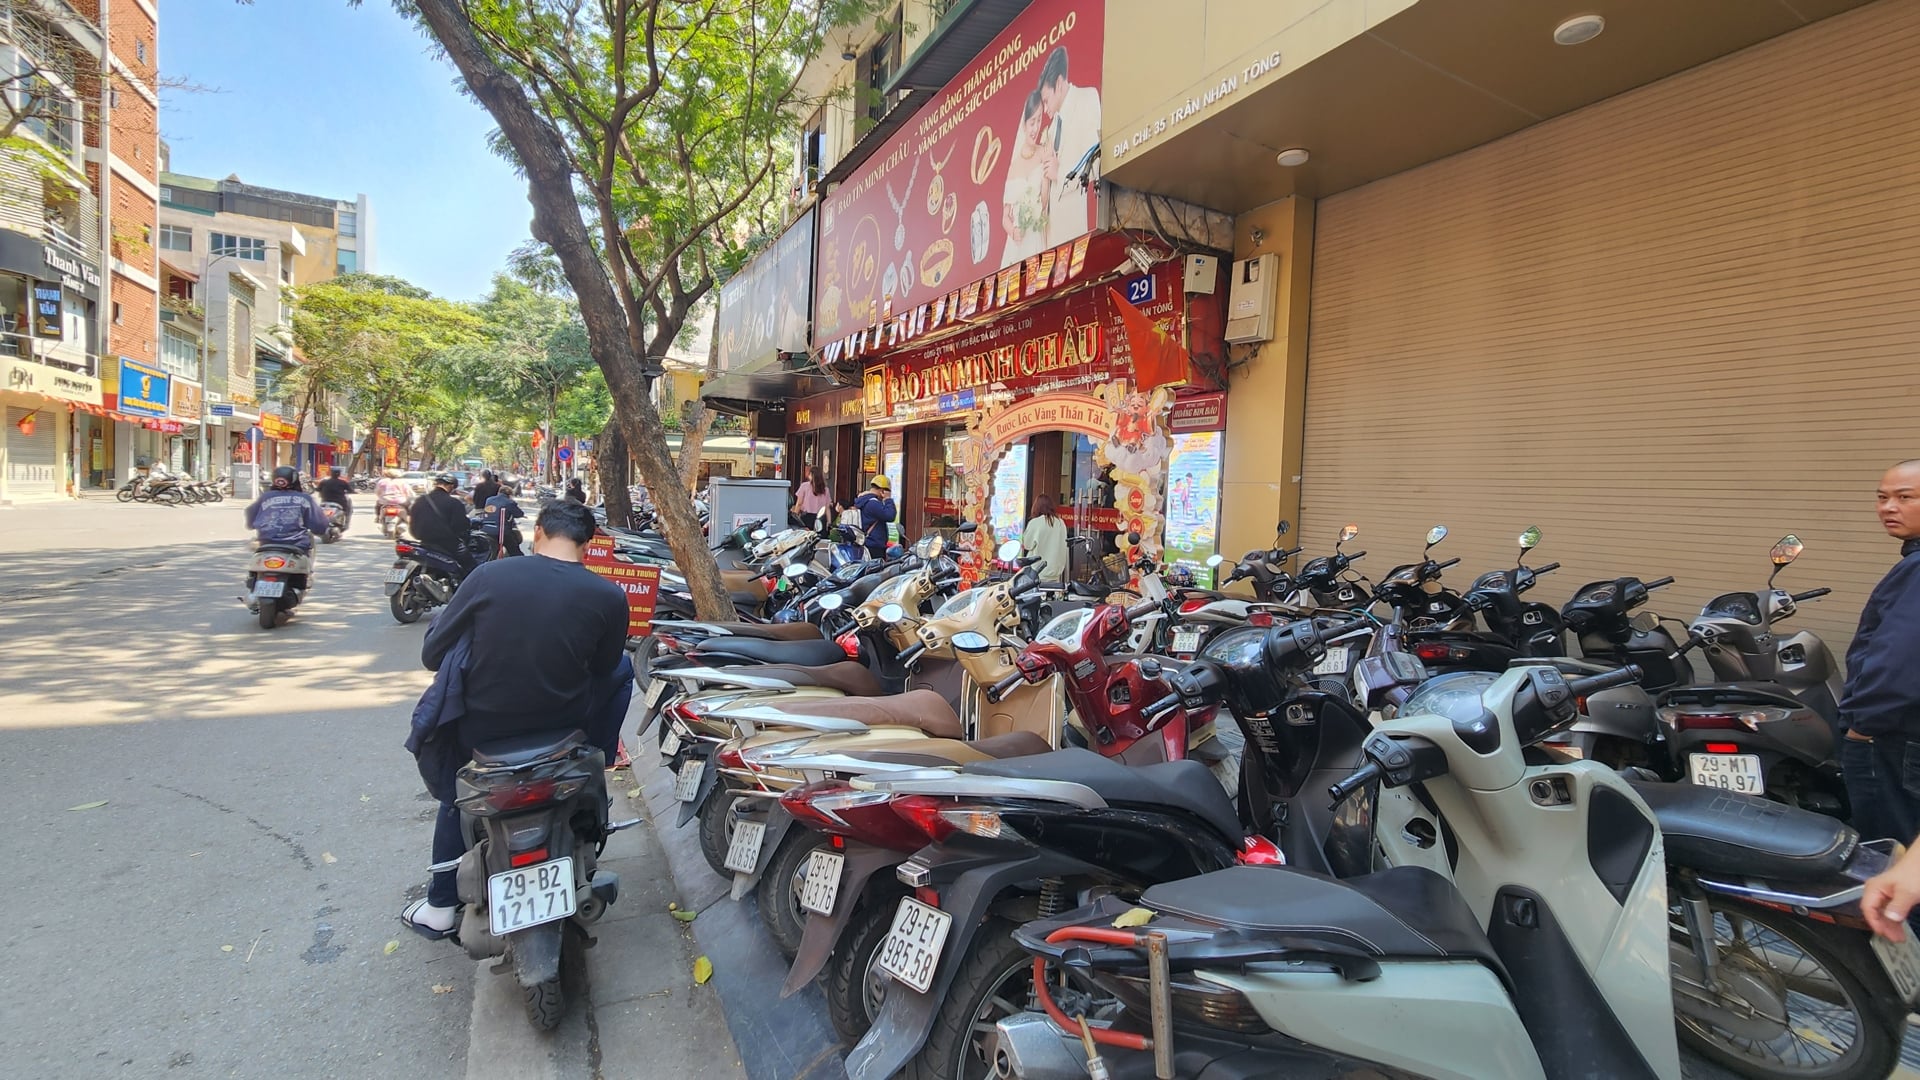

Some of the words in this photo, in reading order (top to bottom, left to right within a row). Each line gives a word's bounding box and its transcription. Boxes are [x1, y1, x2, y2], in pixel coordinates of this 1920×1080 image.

[918, 128, 938, 157] VÀNG
[938, 106, 965, 139] TRANG
[965, 92, 982, 118] SỨC
[983, 67, 1009, 100] CHẤT
[1009, 35, 1047, 80] LƯỢNG
[1049, 11, 1077, 45] CAO
[919, 110, 939, 136] VÀNG
[939, 89, 963, 119] RỒNG
[963, 59, 993, 99] THĂNG
[994, 34, 1022, 71] LONG
[1113, 140, 1129, 158] ĐỊA
[1154, 117, 1167, 135] 35
[1170, 99, 1200, 126] TRẦN
[1203, 75, 1238, 106] NHÂN
[1242, 51, 1281, 83] TÔNG
[838, 192, 851, 215] BẢO
[852, 181, 864, 203] TÍN
[864, 160, 886, 193] MINH
[886, 139, 911, 173] CHÂU
[44, 246, 80, 277] Thanh
[1130, 279, 1149, 301] 29
[890, 363, 920, 403] BẢO
[954, 344, 1016, 391] MINH
[1019, 316, 1100, 376] CHÂU
[1017, 412, 1032, 427] Lộc
[1034, 407, 1057, 421] Vàng
[1087, 408, 1104, 426] Tài
[592, 547, 608, 557] DÂN
[614, 566, 626, 577] HAI
[629, 582, 651, 594] DÂN
[1700, 756, 1748, 773] 29-M1
[1697, 773, 1756, 792] 958.97
[502, 864, 561, 901] 29-B2
[810, 854, 838, 883] 29-C1
[498, 888, 569, 929] 121.71
[899, 904, 942, 948] 29-E1
[883, 935, 933, 985] 985.58
